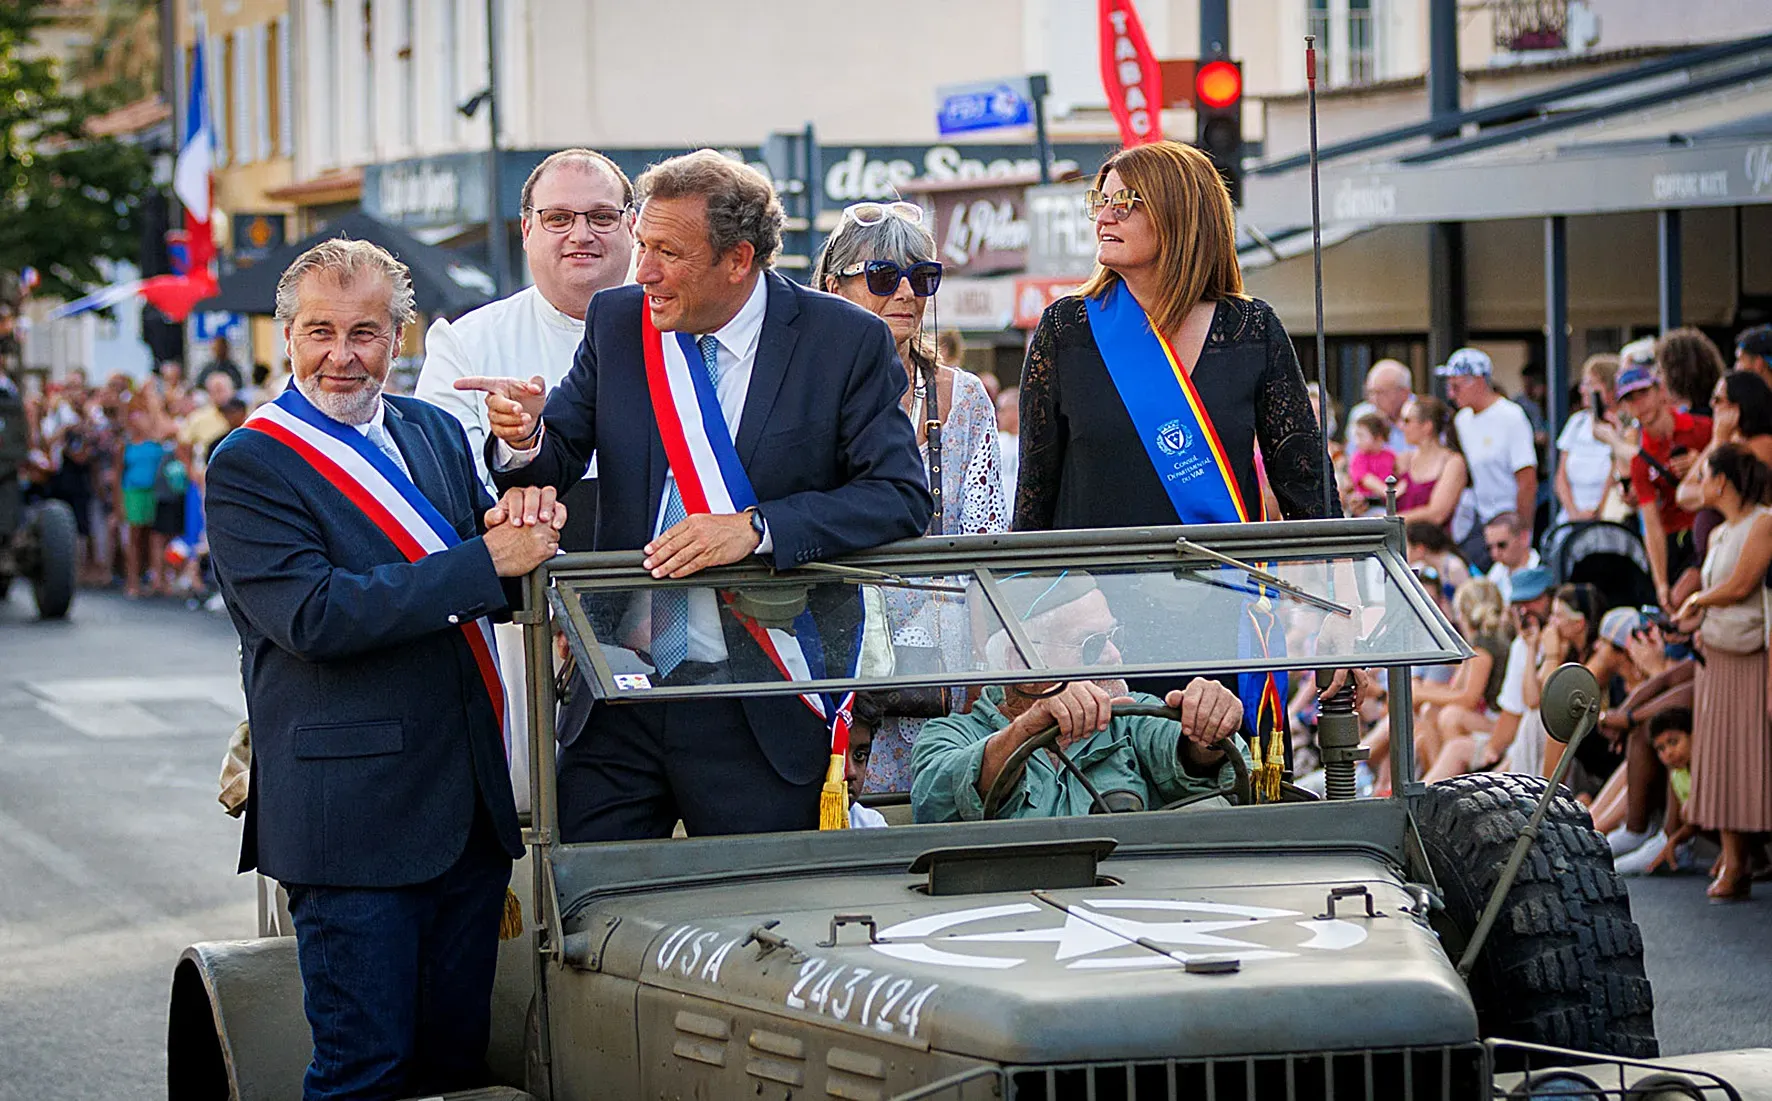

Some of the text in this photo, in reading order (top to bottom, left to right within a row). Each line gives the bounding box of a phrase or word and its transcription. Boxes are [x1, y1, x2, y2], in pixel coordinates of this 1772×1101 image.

[1107, 9, 1152, 136] TABAC
[824, 149, 917, 200] des
[1190, 468, 1205, 479] VAR
[656, 924, 741, 983] USA
[786, 956, 939, 1040] 243124
